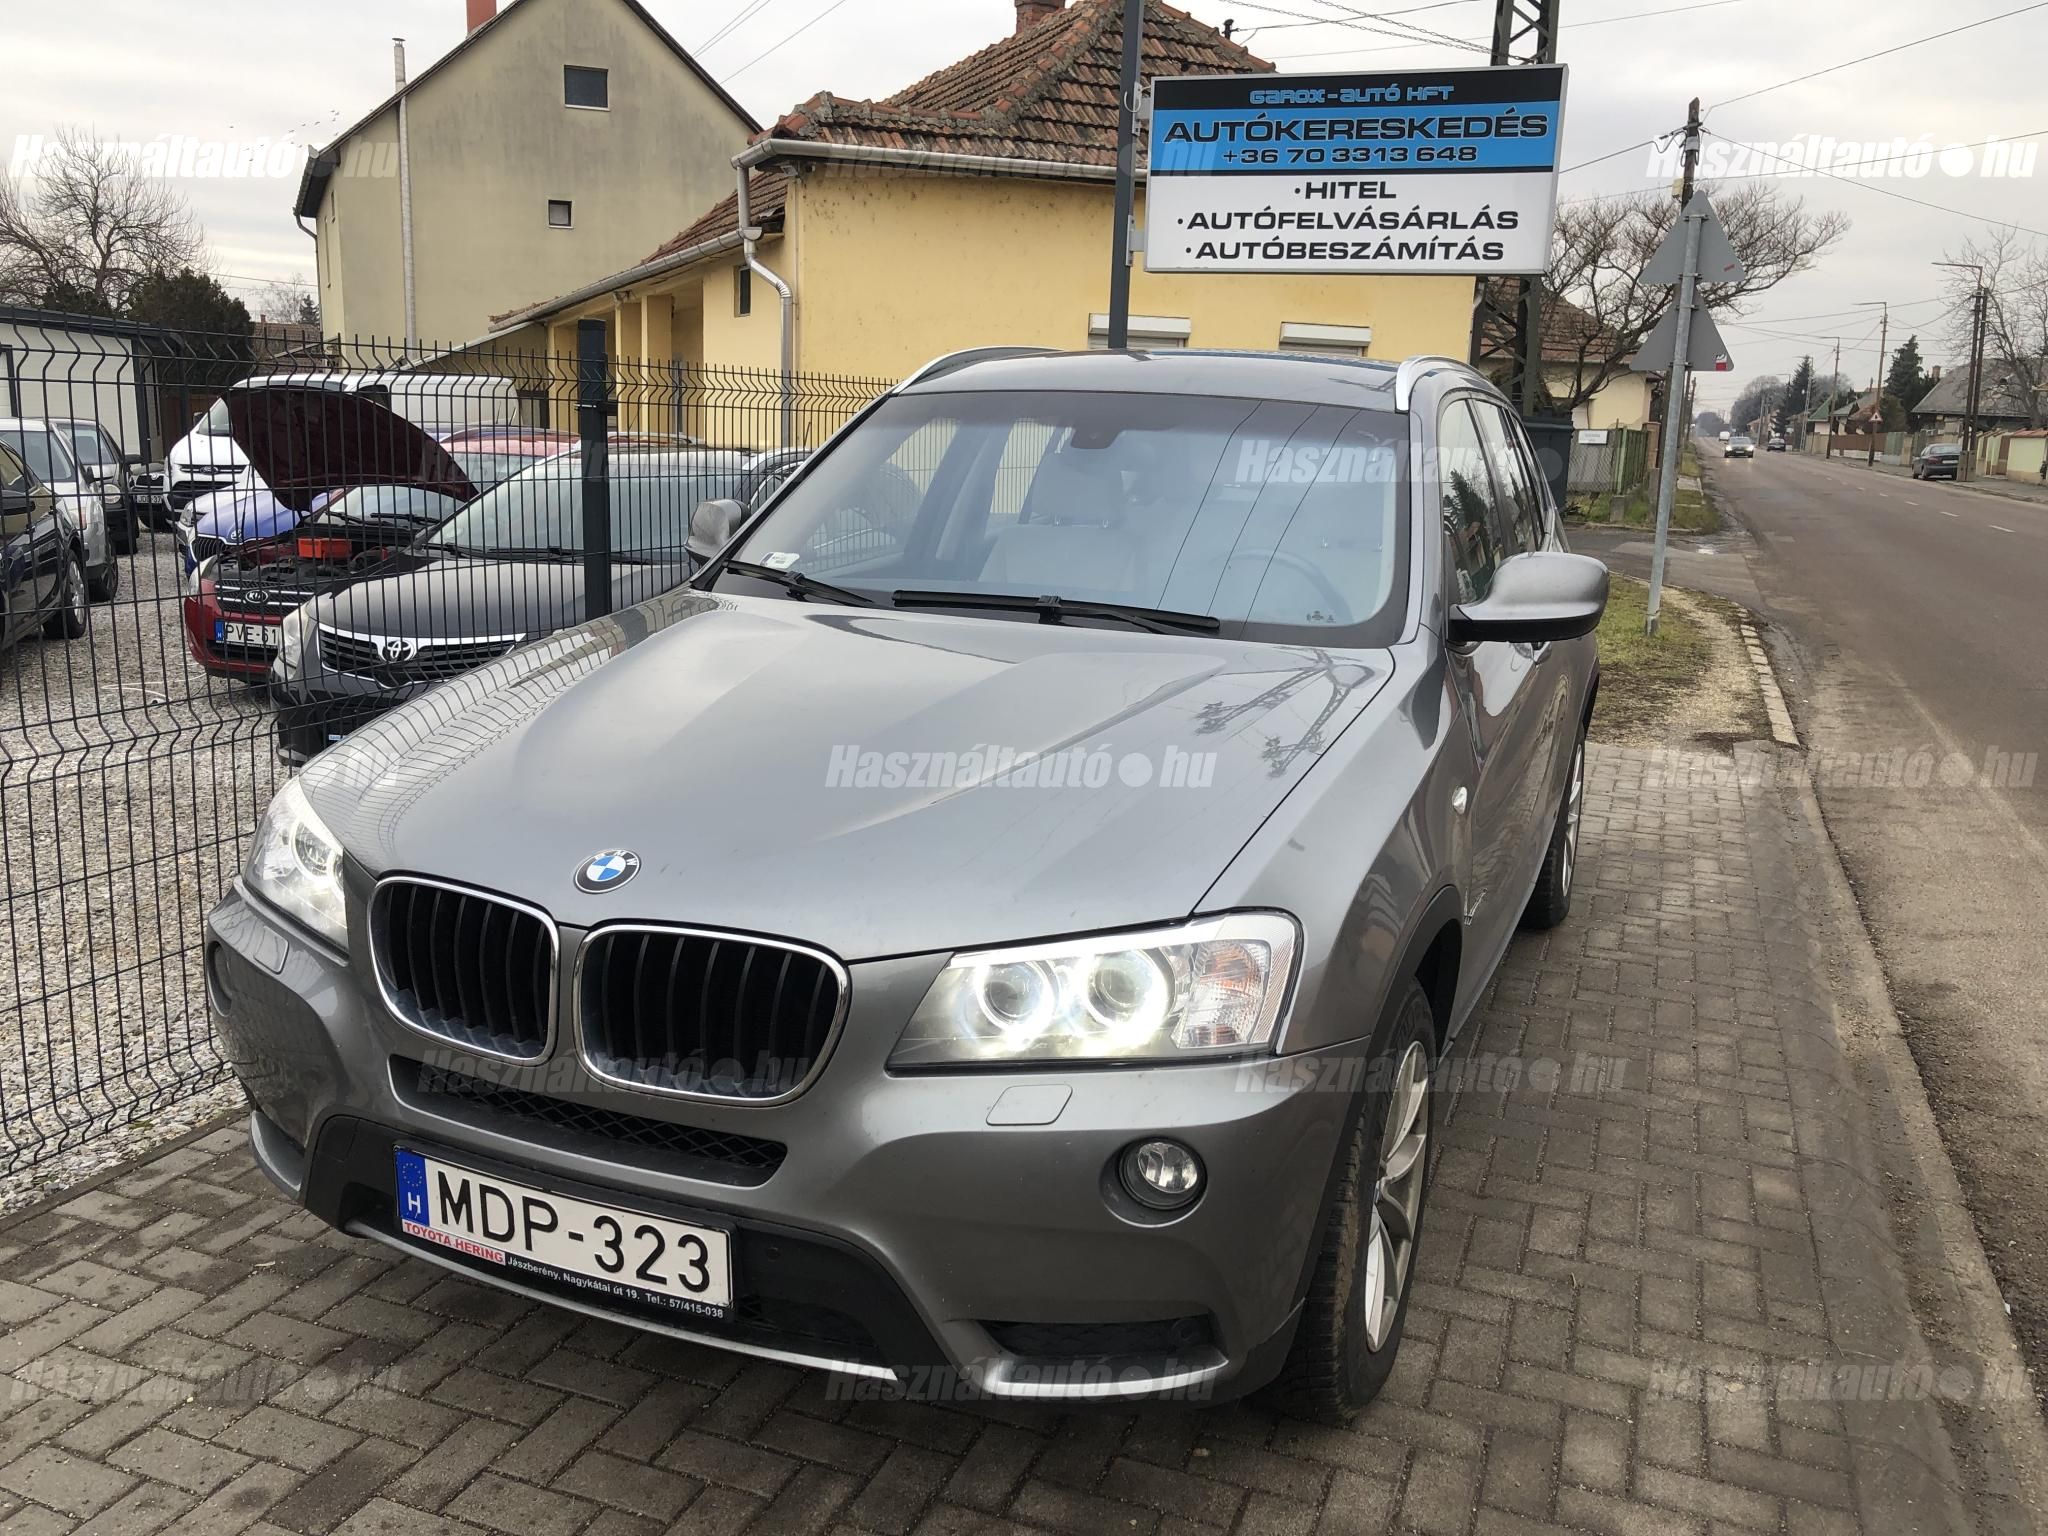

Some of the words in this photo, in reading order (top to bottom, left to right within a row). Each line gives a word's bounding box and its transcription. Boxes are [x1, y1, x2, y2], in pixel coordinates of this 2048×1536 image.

[1163, 107, 1548, 144] AUTÓKERESKEDÉS
[1223, 149, 1279, 164] +36
[1287, 147, 1325, 163] 70
[1331, 147, 1409, 162] 3313
[1416, 146, 1478, 162] 648
[1304, 181, 1397, 200] HITEL
[1187, 205, 1520, 231] AUTÓFELVÁSÁRLÁS
[1195, 235, 1505, 261] AUTÓBESZÁMÍTÁS
[407, 1191, 421, 1214] H
[437, 1170, 711, 1294] MDP-323
[404, 1221, 452, 1246] TOYOTA
[454, 1238, 504, 1263] HERING
[563, 1273, 611, 1293] Nagykátai
[613, 1285, 624, 1296] út
[669, 1299, 724, 1319] 57/415-038
